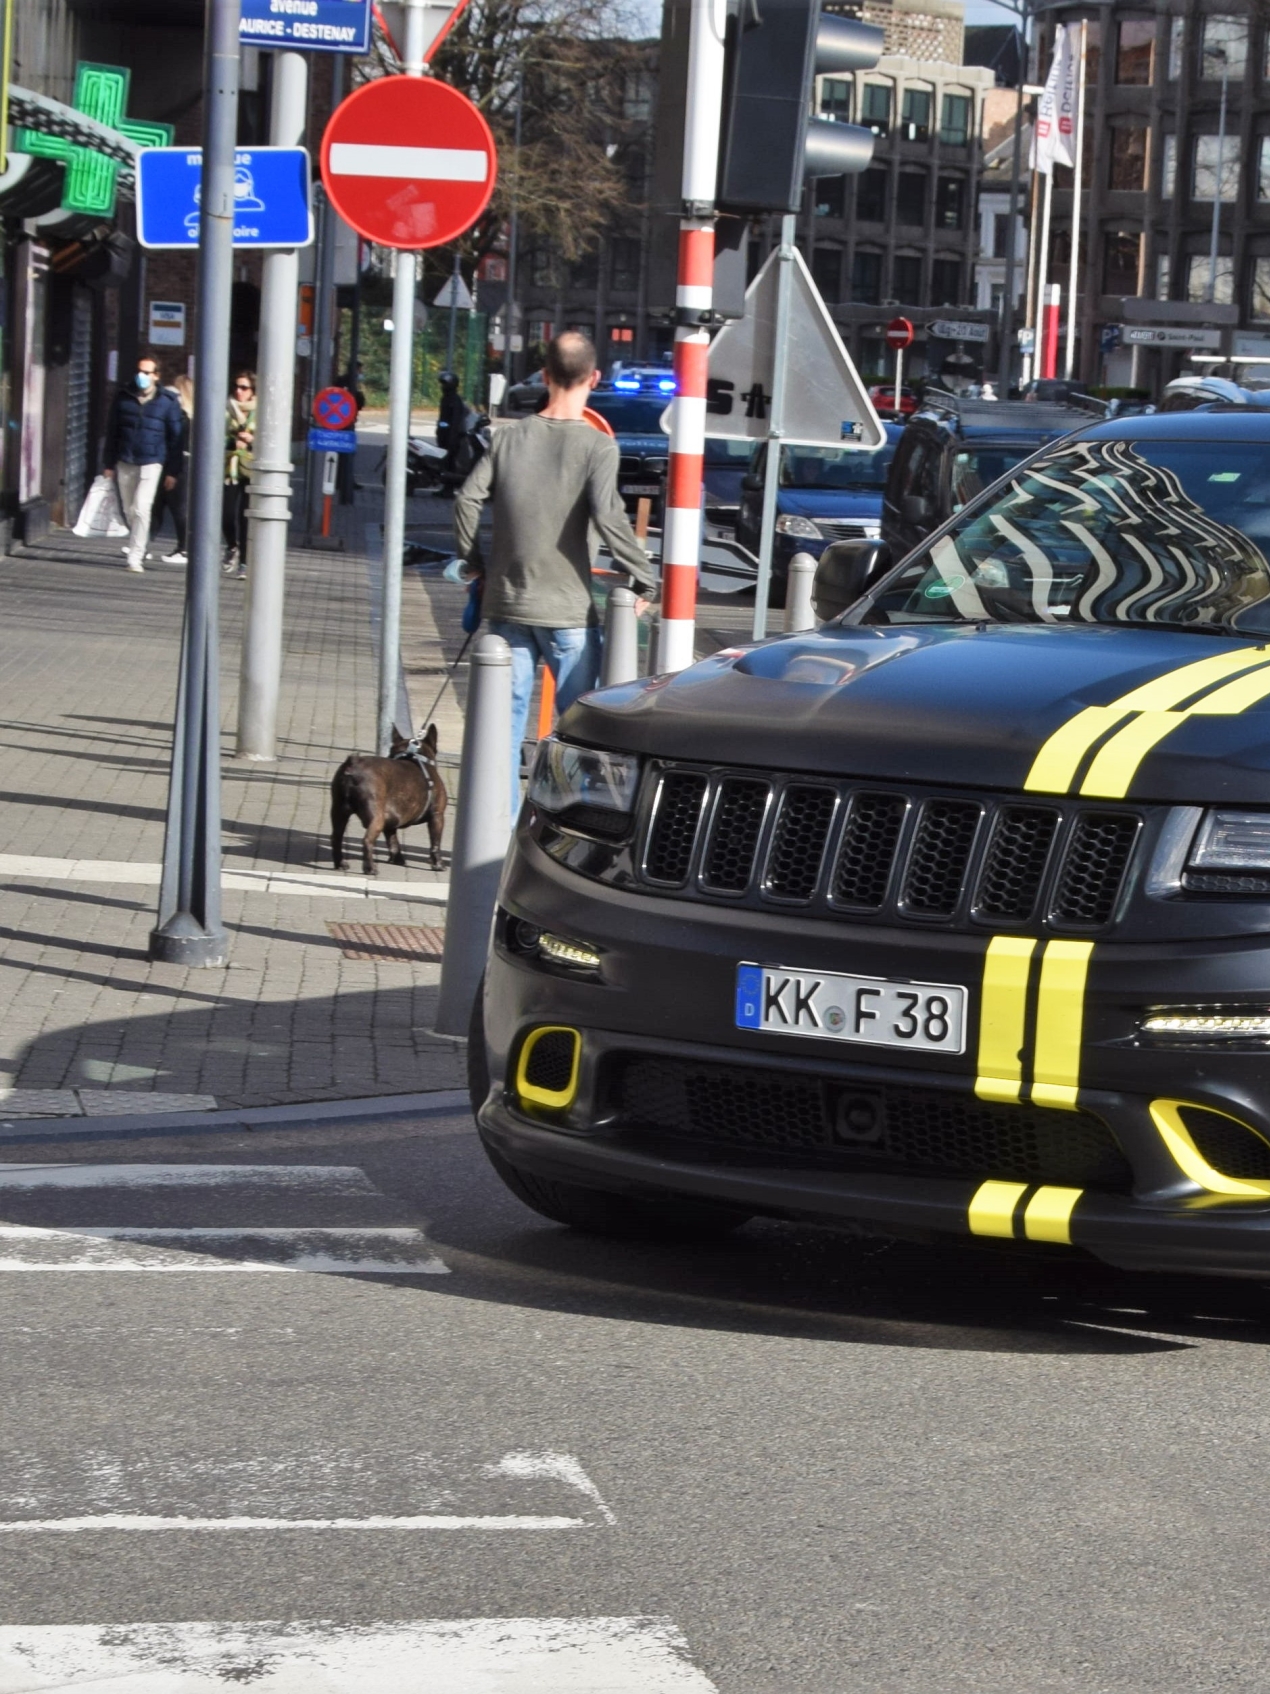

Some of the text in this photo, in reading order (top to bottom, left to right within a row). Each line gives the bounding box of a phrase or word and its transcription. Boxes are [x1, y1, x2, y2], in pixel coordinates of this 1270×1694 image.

[270, 0, 318, 16] avenue
[239, 18, 285, 36] AURICE
[744, 1003, 755, 1017] D
[764, 975, 949, 1042] KK F 38
